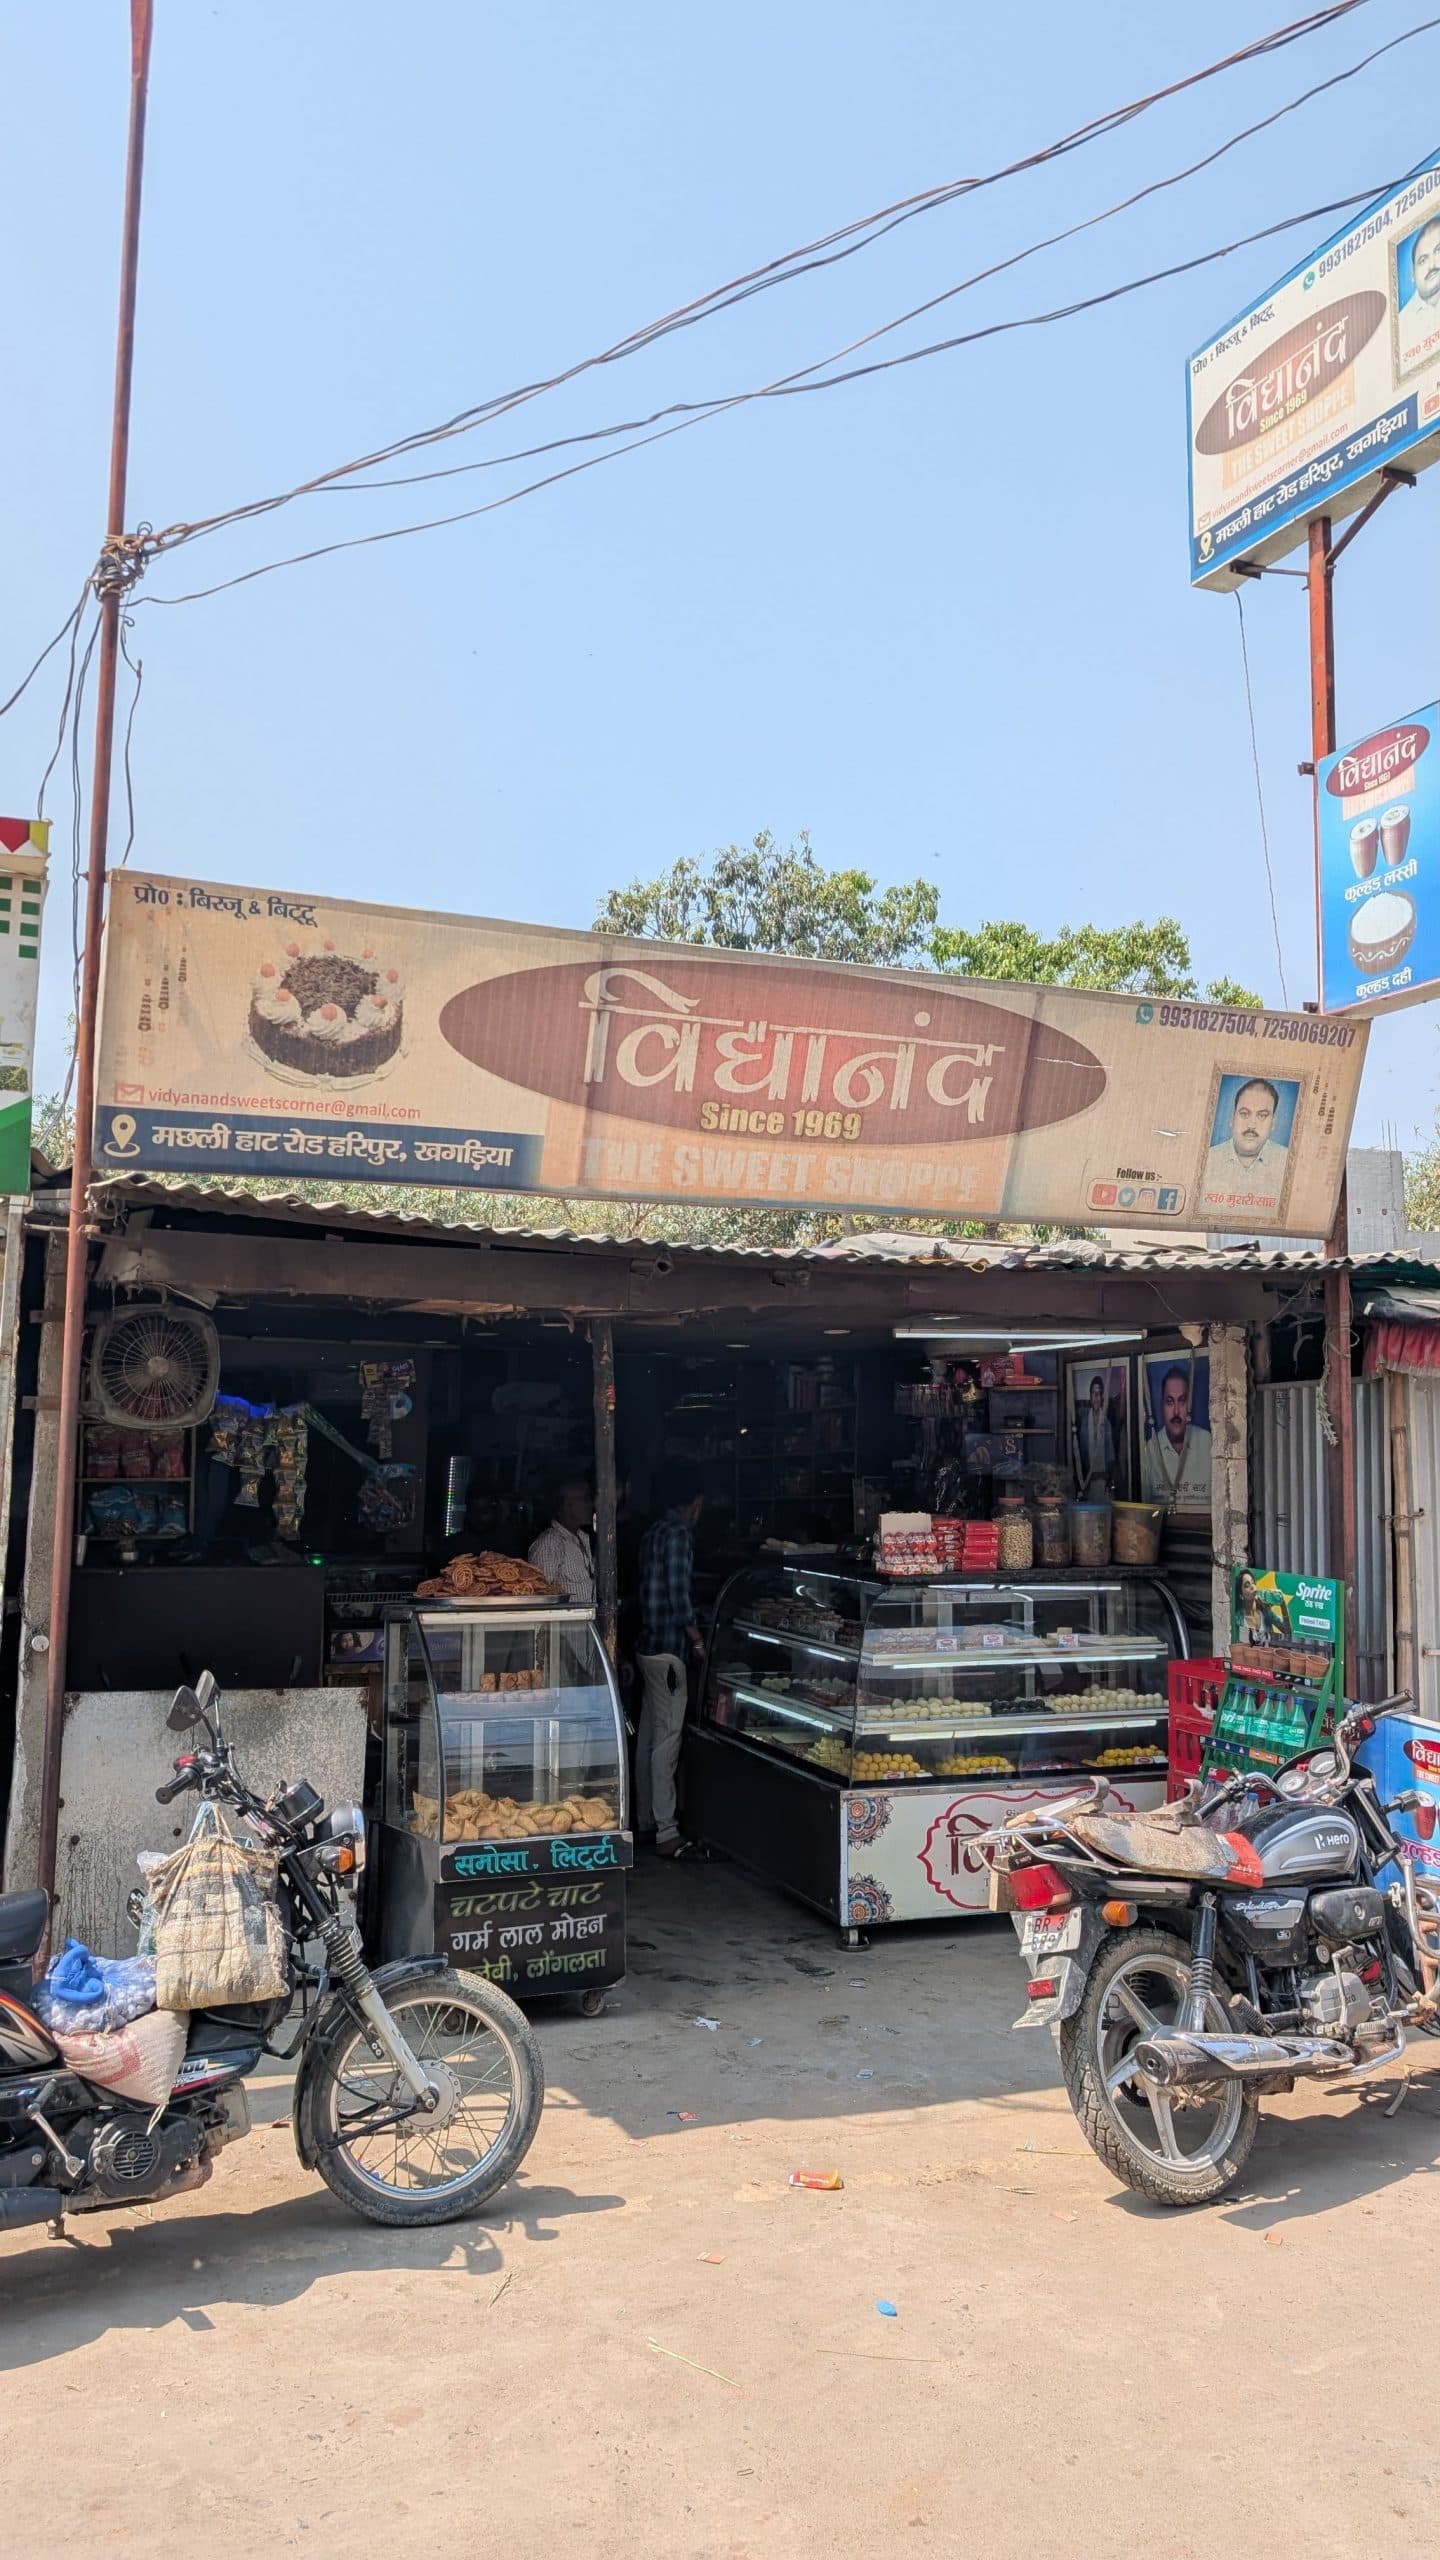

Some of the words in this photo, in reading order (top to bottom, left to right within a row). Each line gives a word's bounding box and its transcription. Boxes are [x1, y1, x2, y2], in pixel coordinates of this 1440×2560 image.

[1286, 389, 1308, 414] 1969
[1215, 509, 1252, 543] मछली
[1253, 499, 1275, 521] हाट
[190, 887, 247, 920] बिरजू
[249, 901, 261, 914] &
[1159, 1005, 1258, 1038] 9931827504,
[1262, 1017, 1355, 1048] 7258069207
[148, 1088, 422, 1120] vidyanandsweetscorner@gmail.com
[700, 1102, 785, 1136] Since
[792, 1109, 863, 1140] 1969
[152, 1123, 232, 1150] मछली
[235, 1129, 279, 1152] हाट
[281, 1128, 326, 1155] रोड
[328, 1132, 407, 1166] हरिपुर,
[414, 1138, 514, 1171] खगड़िया
[583, 1137, 661, 1185] THE
[672, 1145, 817, 1191] SWEET
[825, 1156, 982, 1203] SHOPPE
[1116, 1168, 1144, 1180] Follow
[1296, 1582, 1332, 1600] Sprite
[1326, 1832, 1350, 1846] Hero
[450, 1881, 545, 1918] चटपटे
[547, 1882, 604, 1908] चाट
[450, 1920, 494, 1952] गर्म
[498, 1923, 545, 1948] लाल
[550, 1912, 607, 1941] मोहन
[1033, 1916, 1050, 1933] BR
